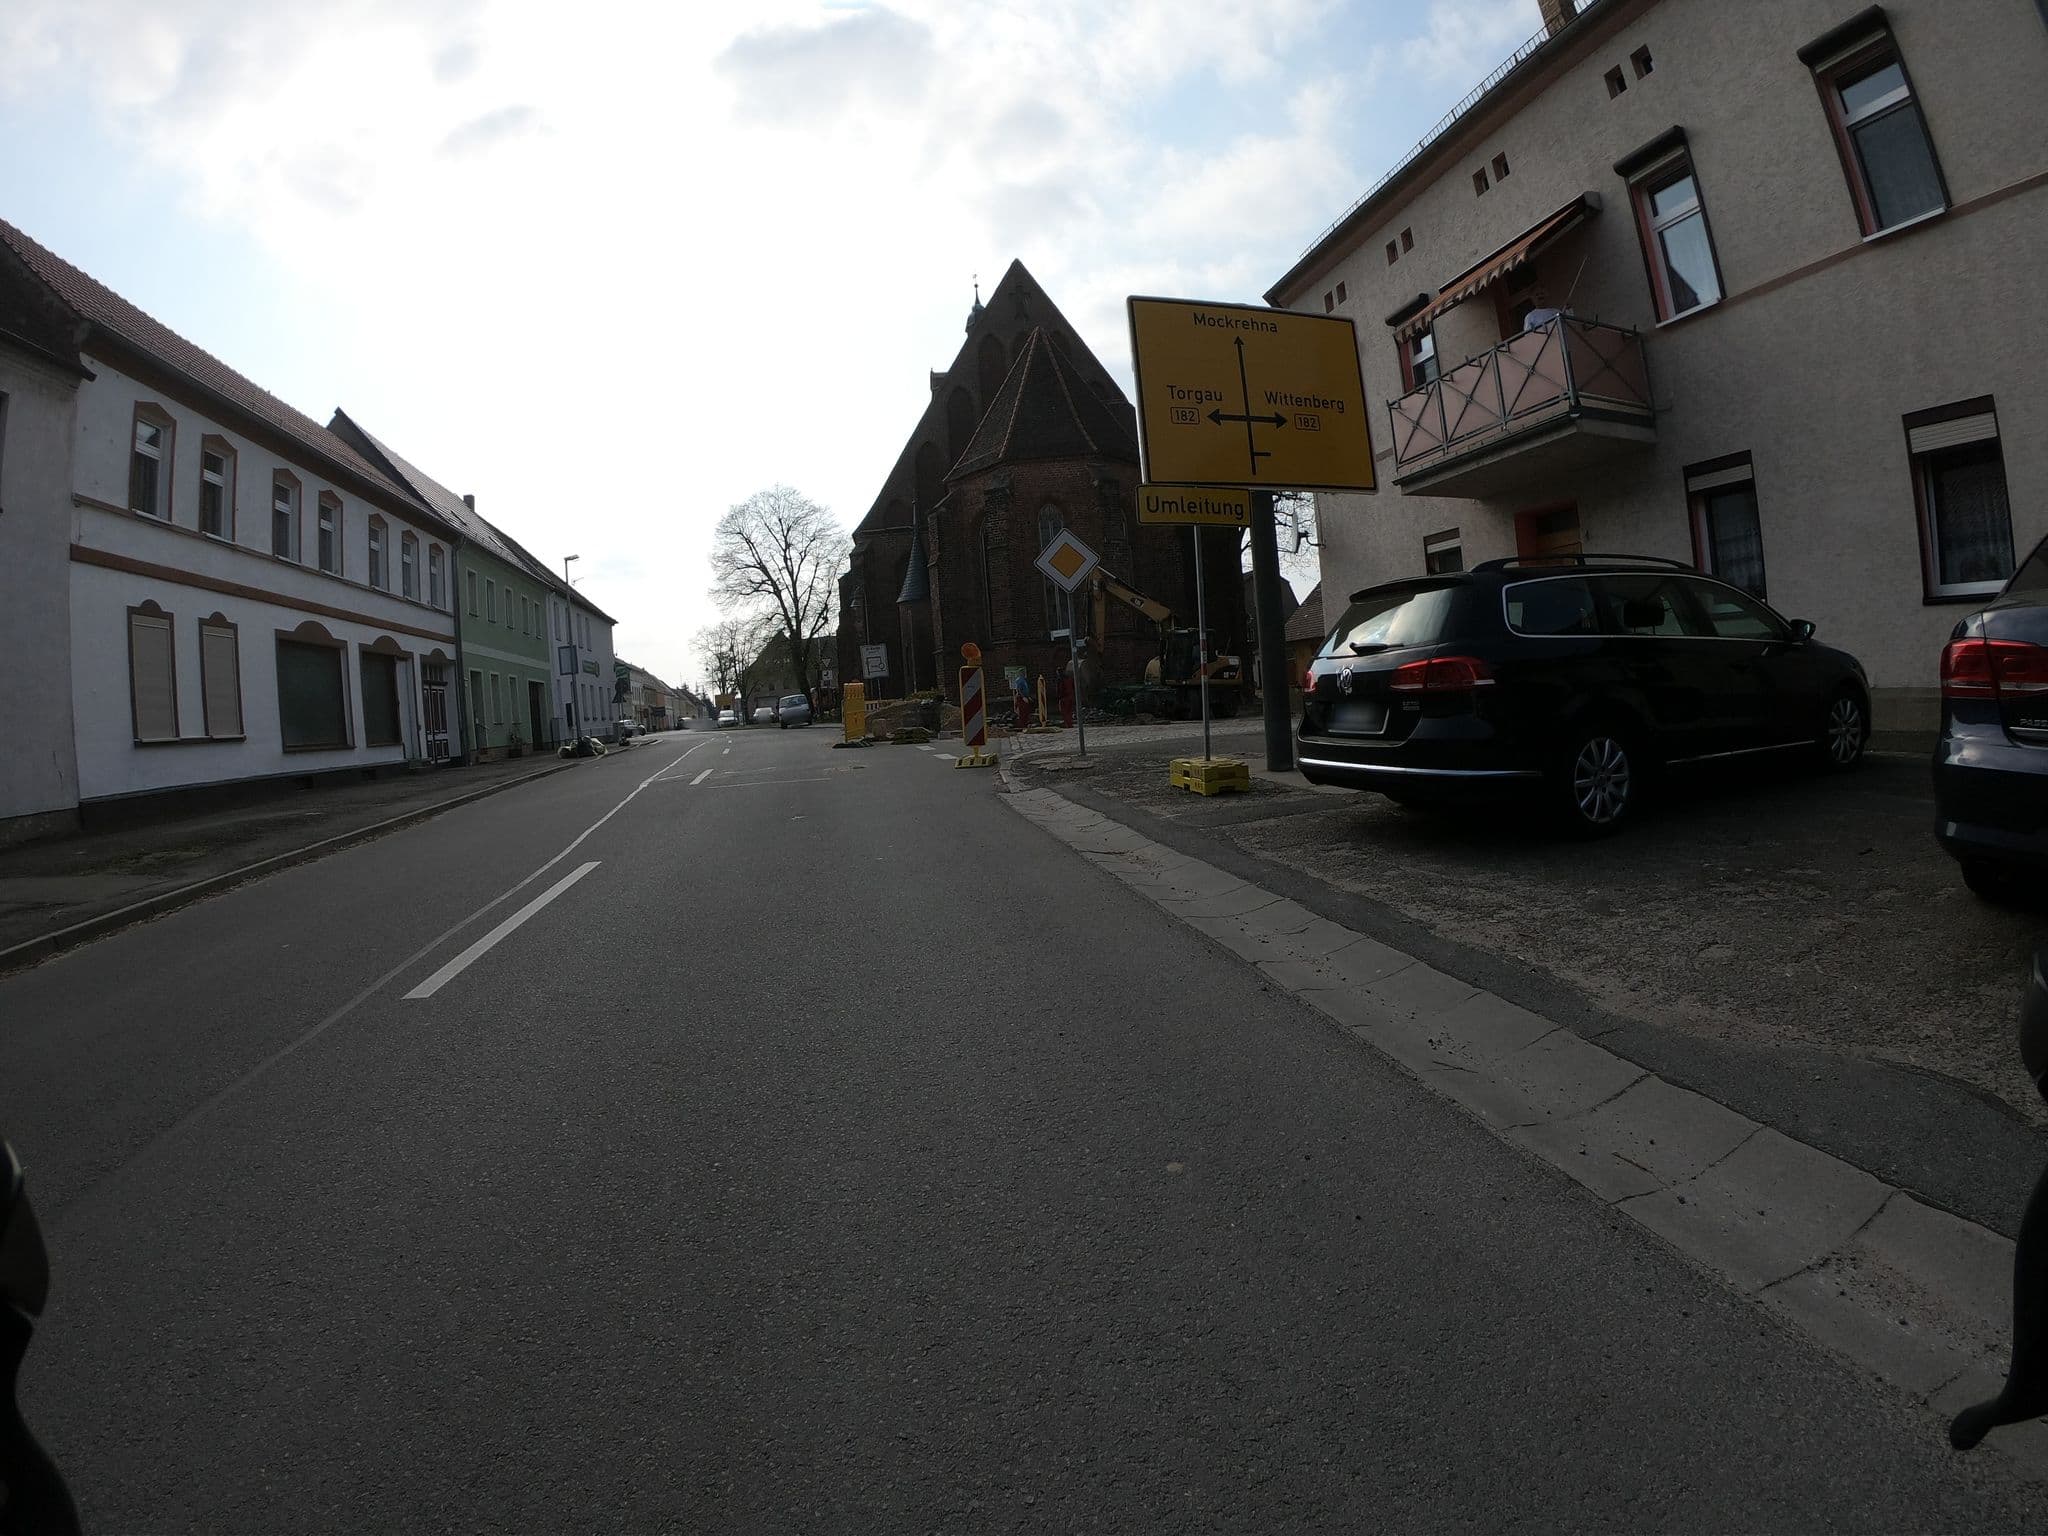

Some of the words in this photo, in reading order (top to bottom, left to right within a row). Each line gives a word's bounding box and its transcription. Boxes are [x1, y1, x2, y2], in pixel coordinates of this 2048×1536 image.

[1193, 312, 1278, 333] Mockrehna
[1167, 385, 1223, 404] Torgau
[1264, 391, 1344, 413] Wittenberg
[1175, 409, 1195, 422] 182
[1298, 416, 1317, 429] 182
[1146, 496, 1244, 519] Umleitung
